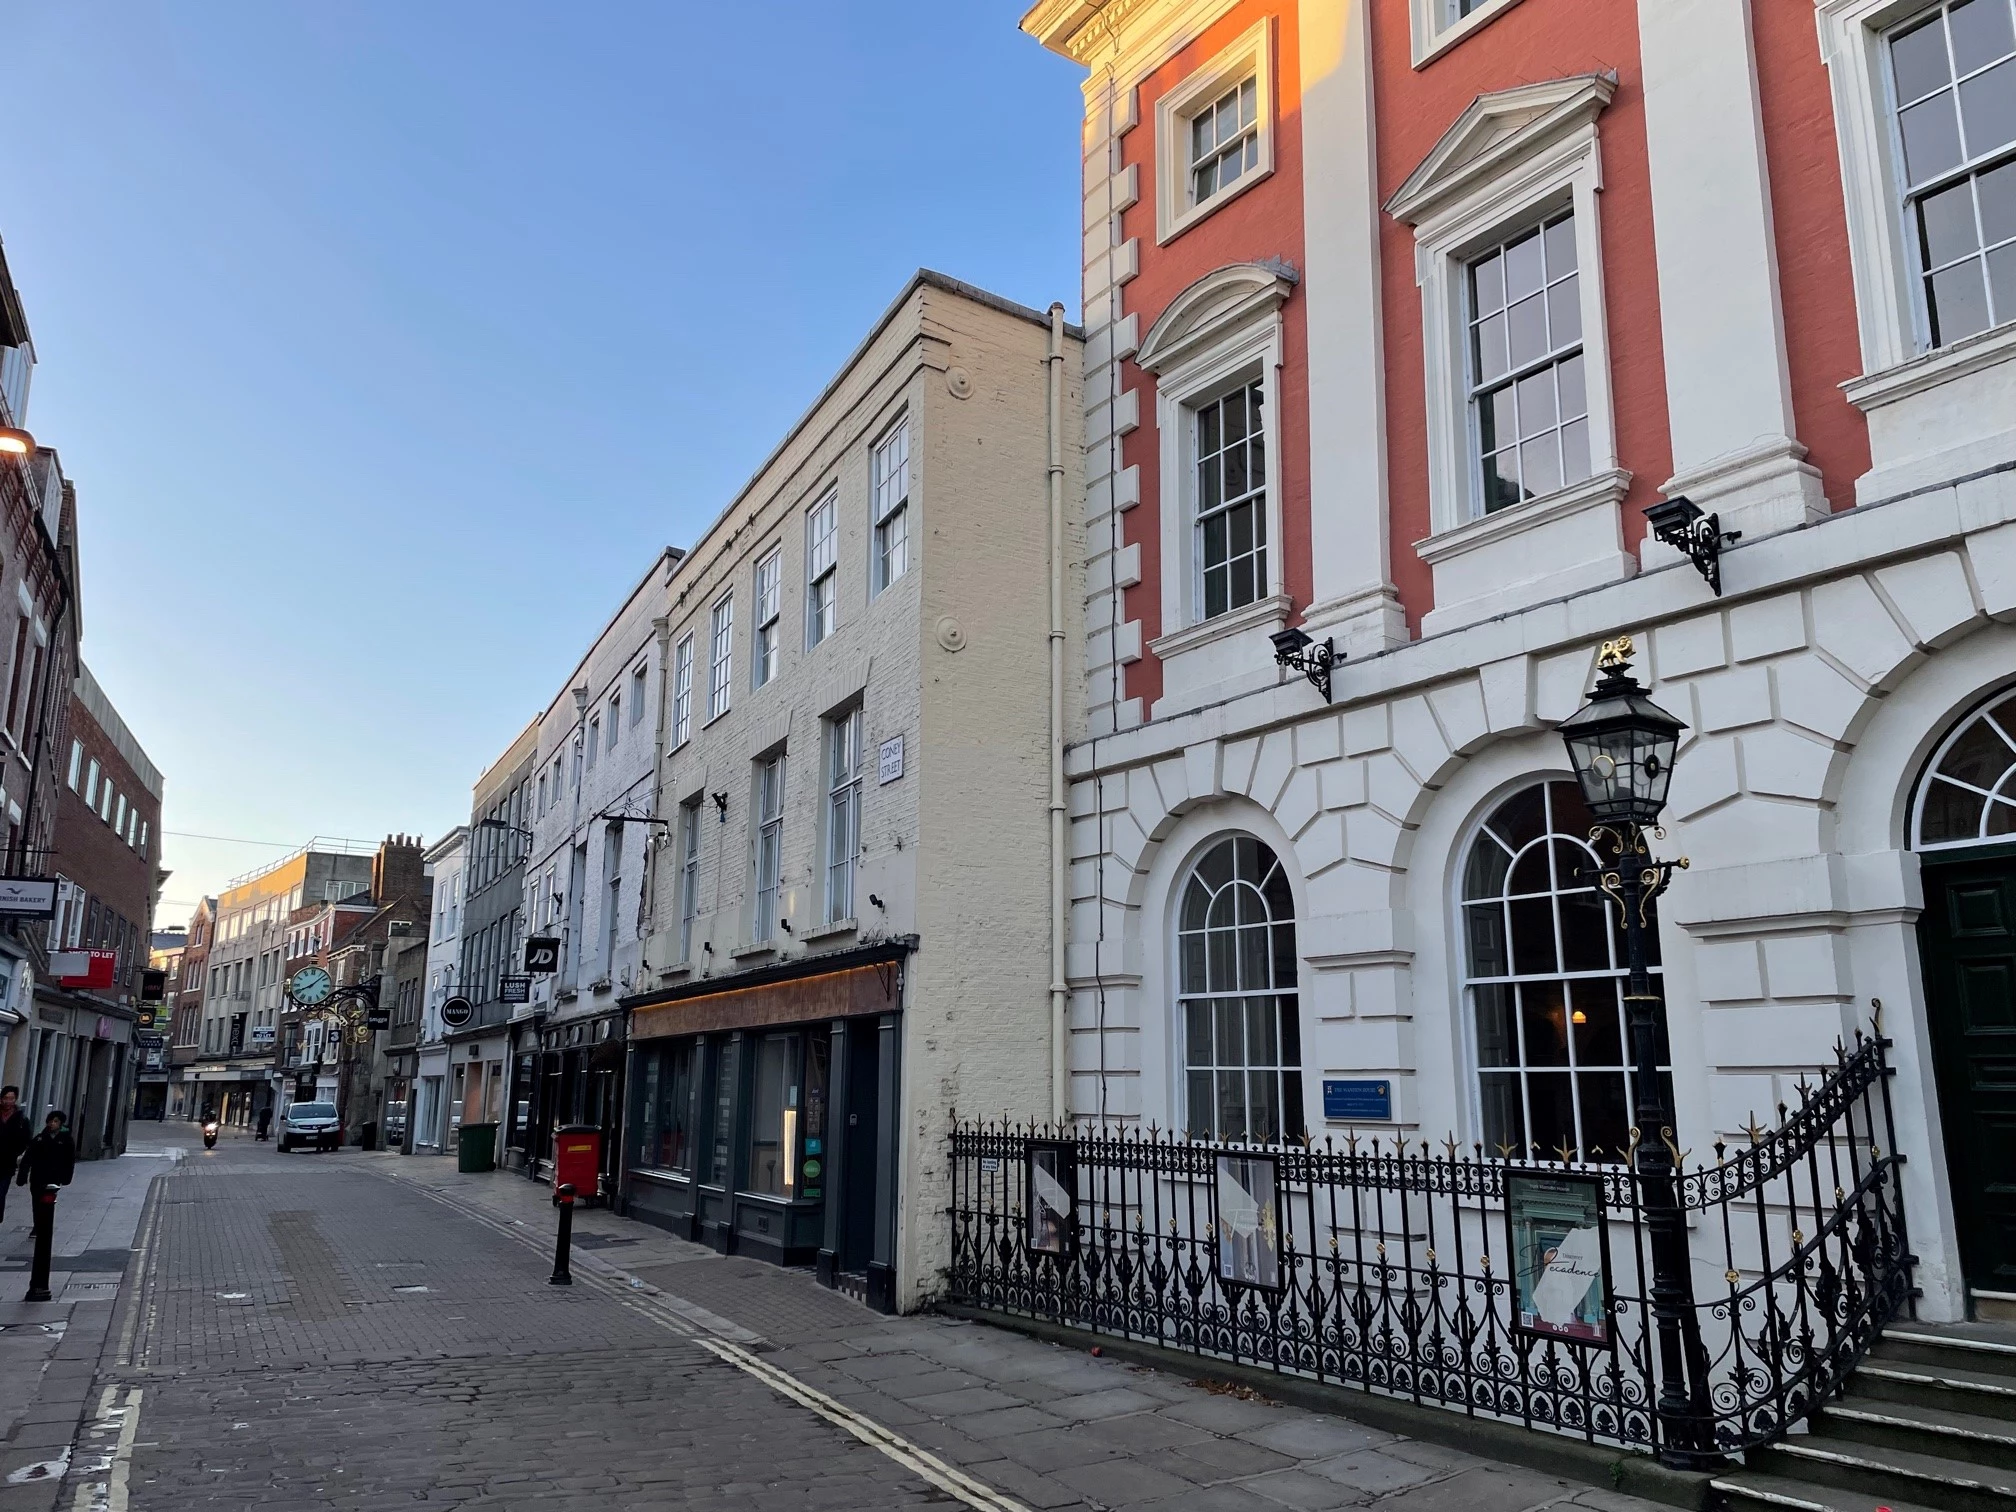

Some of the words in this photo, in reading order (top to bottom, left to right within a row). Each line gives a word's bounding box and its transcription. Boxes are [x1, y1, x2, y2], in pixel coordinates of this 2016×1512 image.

[881, 742, 901, 760] CONEY
[881, 759, 901, 778] STREET
[529, 948, 554, 964] JD
[231, 1023, 240, 1045] next
[330, 1031, 339, 1042] 3
[1517, 1243, 1600, 1277] Decadence
